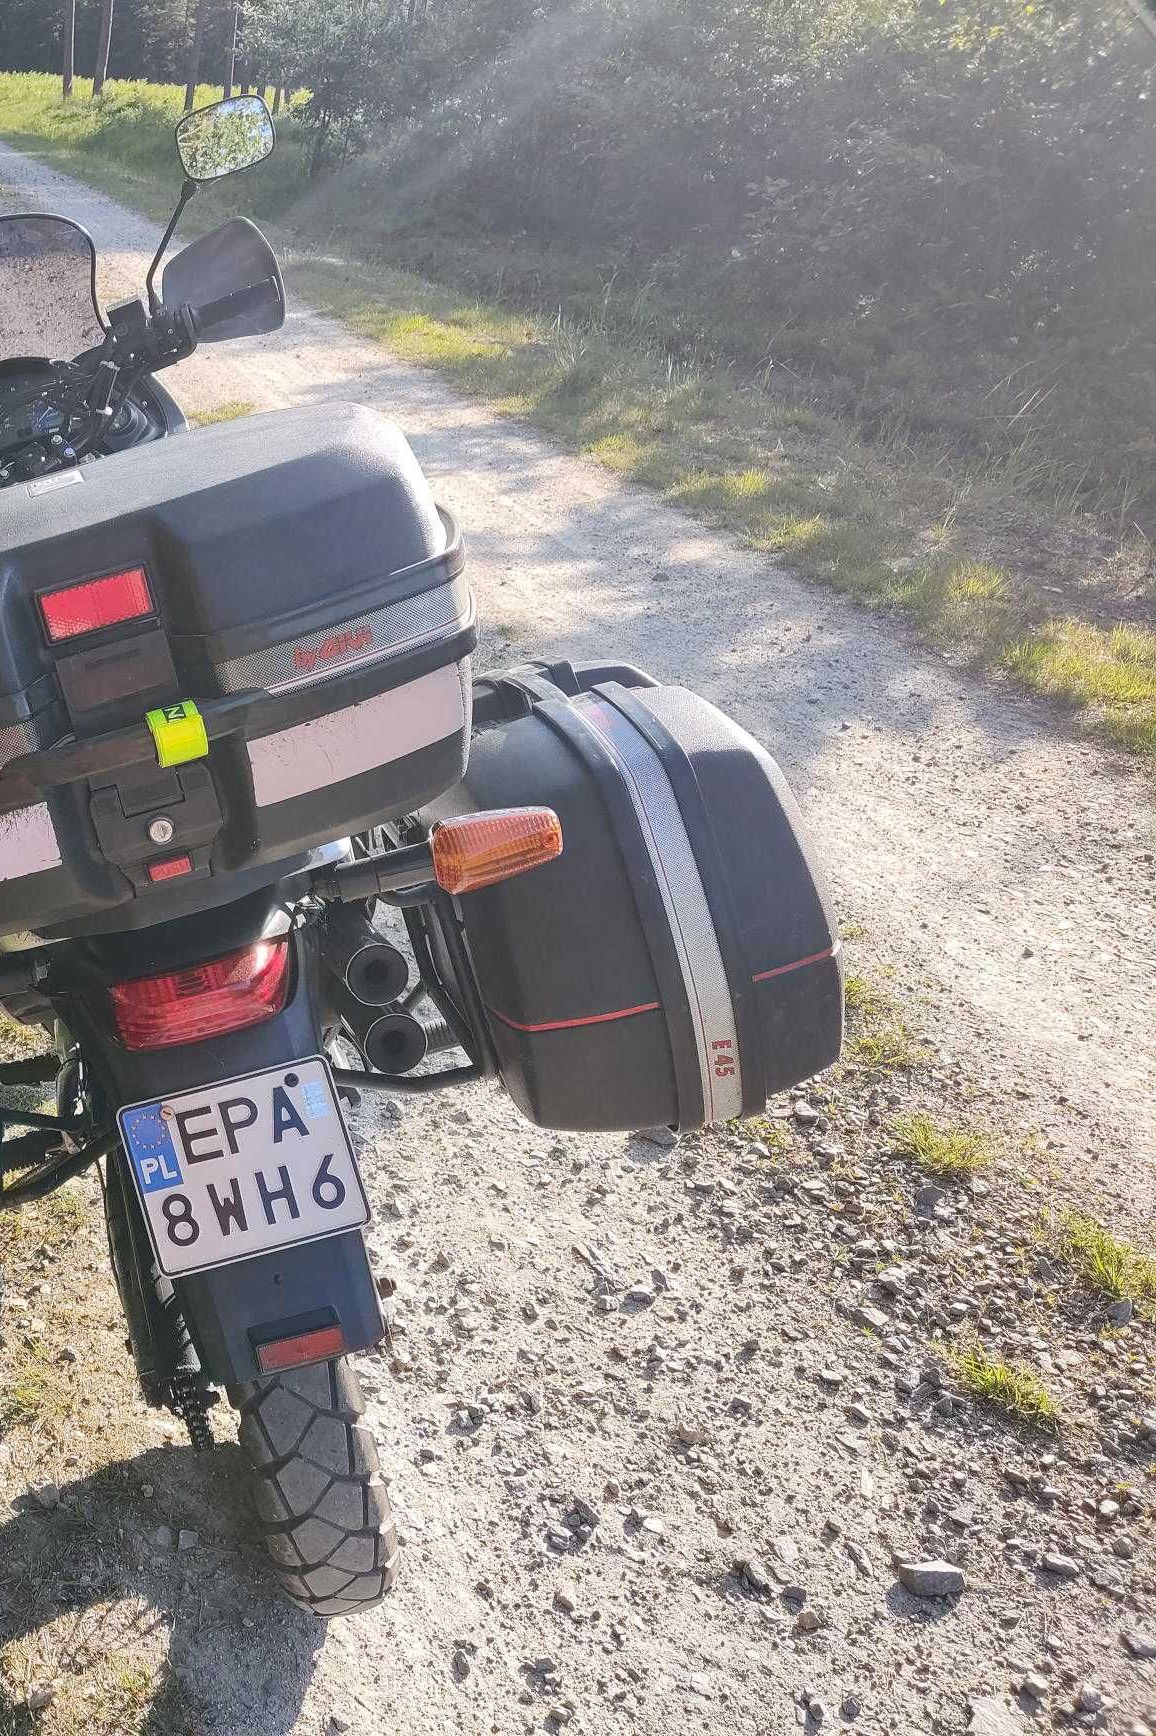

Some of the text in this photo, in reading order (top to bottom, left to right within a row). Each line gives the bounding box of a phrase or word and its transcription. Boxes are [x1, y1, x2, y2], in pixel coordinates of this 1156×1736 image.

[711, 1039, 736, 1077] E 45
[174, 1086, 310, 1165] EPA
[140, 1154, 177, 1185] PL
[161, 1154, 346, 1247] 8WH6
